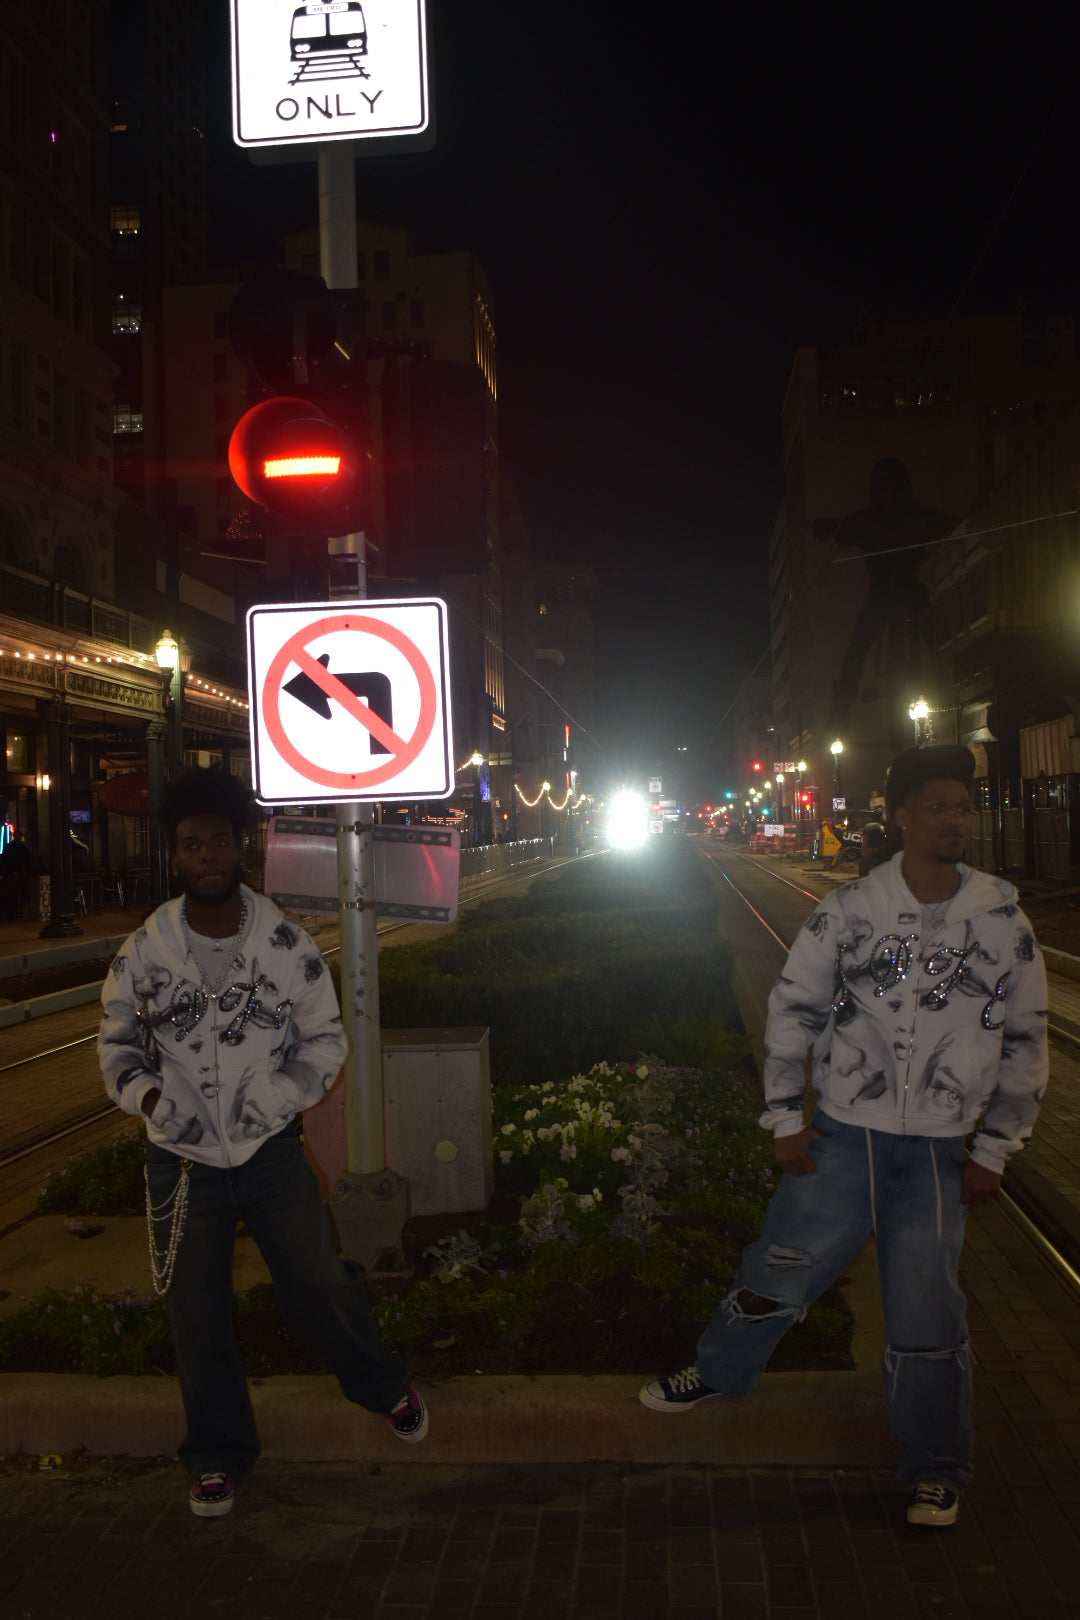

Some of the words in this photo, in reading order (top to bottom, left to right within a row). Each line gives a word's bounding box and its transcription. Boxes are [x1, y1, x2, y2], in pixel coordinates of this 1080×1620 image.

[313, 4, 342, 13] METRO
[275, 90, 384, 121] ONLY
[842, 832, 863, 844] JC
